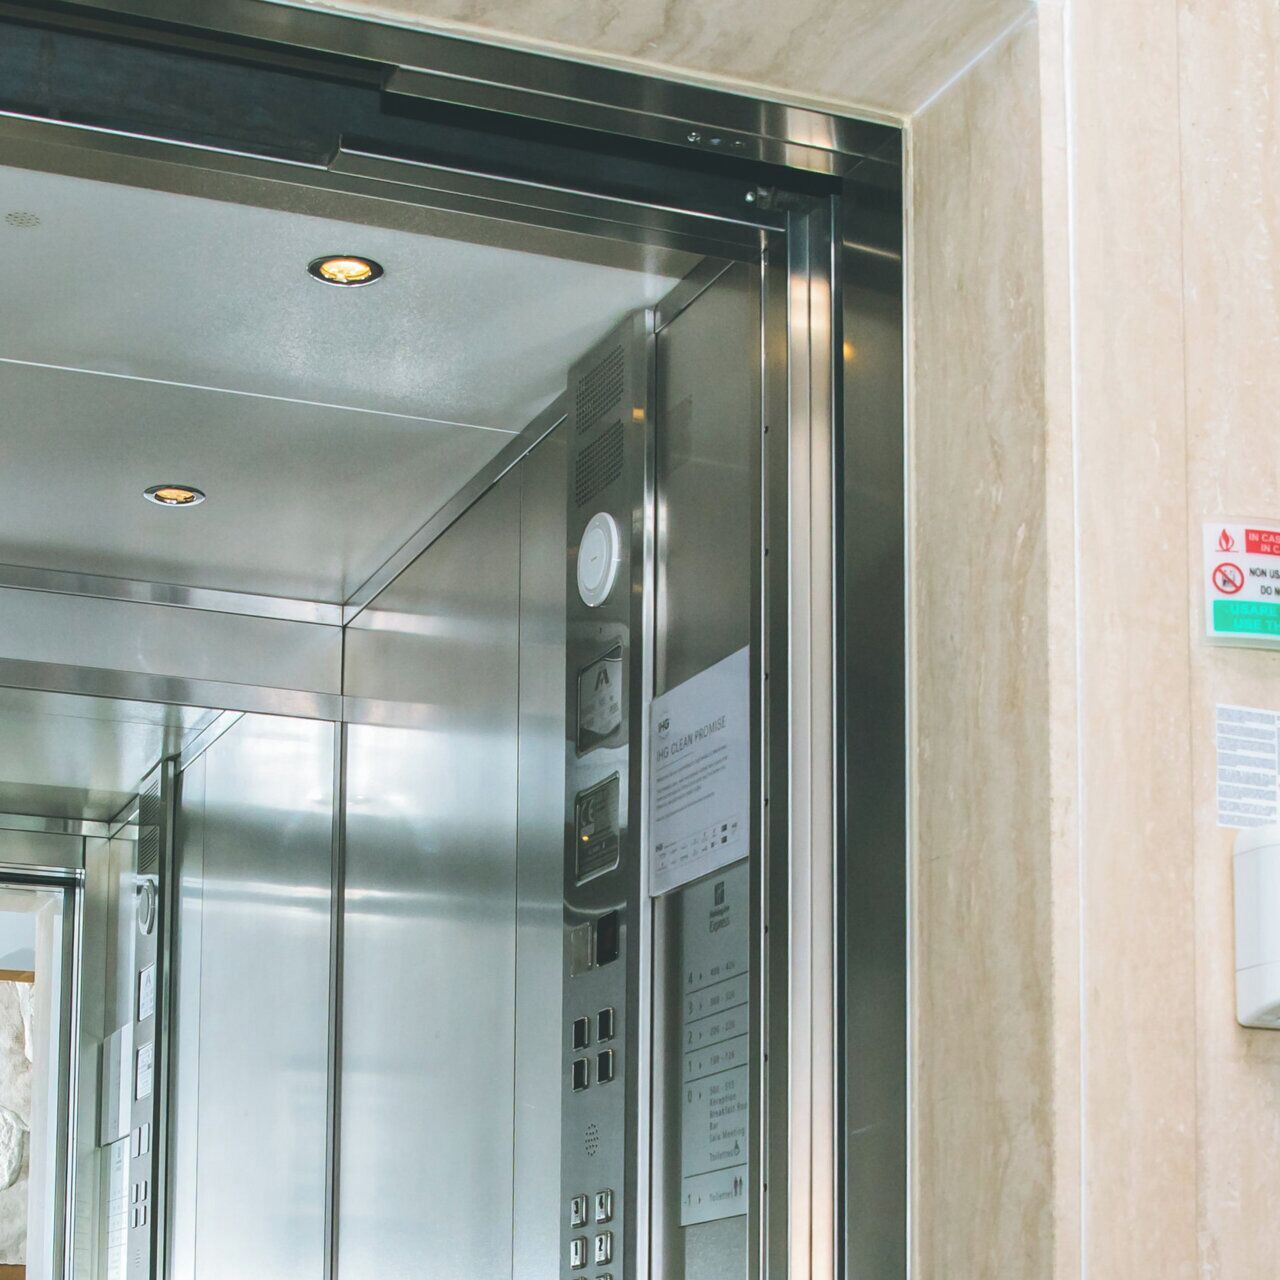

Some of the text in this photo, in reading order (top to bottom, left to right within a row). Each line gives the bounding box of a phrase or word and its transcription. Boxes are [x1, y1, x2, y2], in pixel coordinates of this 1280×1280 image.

[1248, 533, 1259, 542] IN
[1261, 544, 1272, 552] IN
[1249, 567, 1268, 578] NON
[1260, 585, 1272, 596] DO
[1231, 603, 1278, 619] USARE
[1232, 618, 1262, 629] USE
[658, 718, 670, 734] IHG
[657, 715, 727, 762] IHG CLEAN PROMISE
